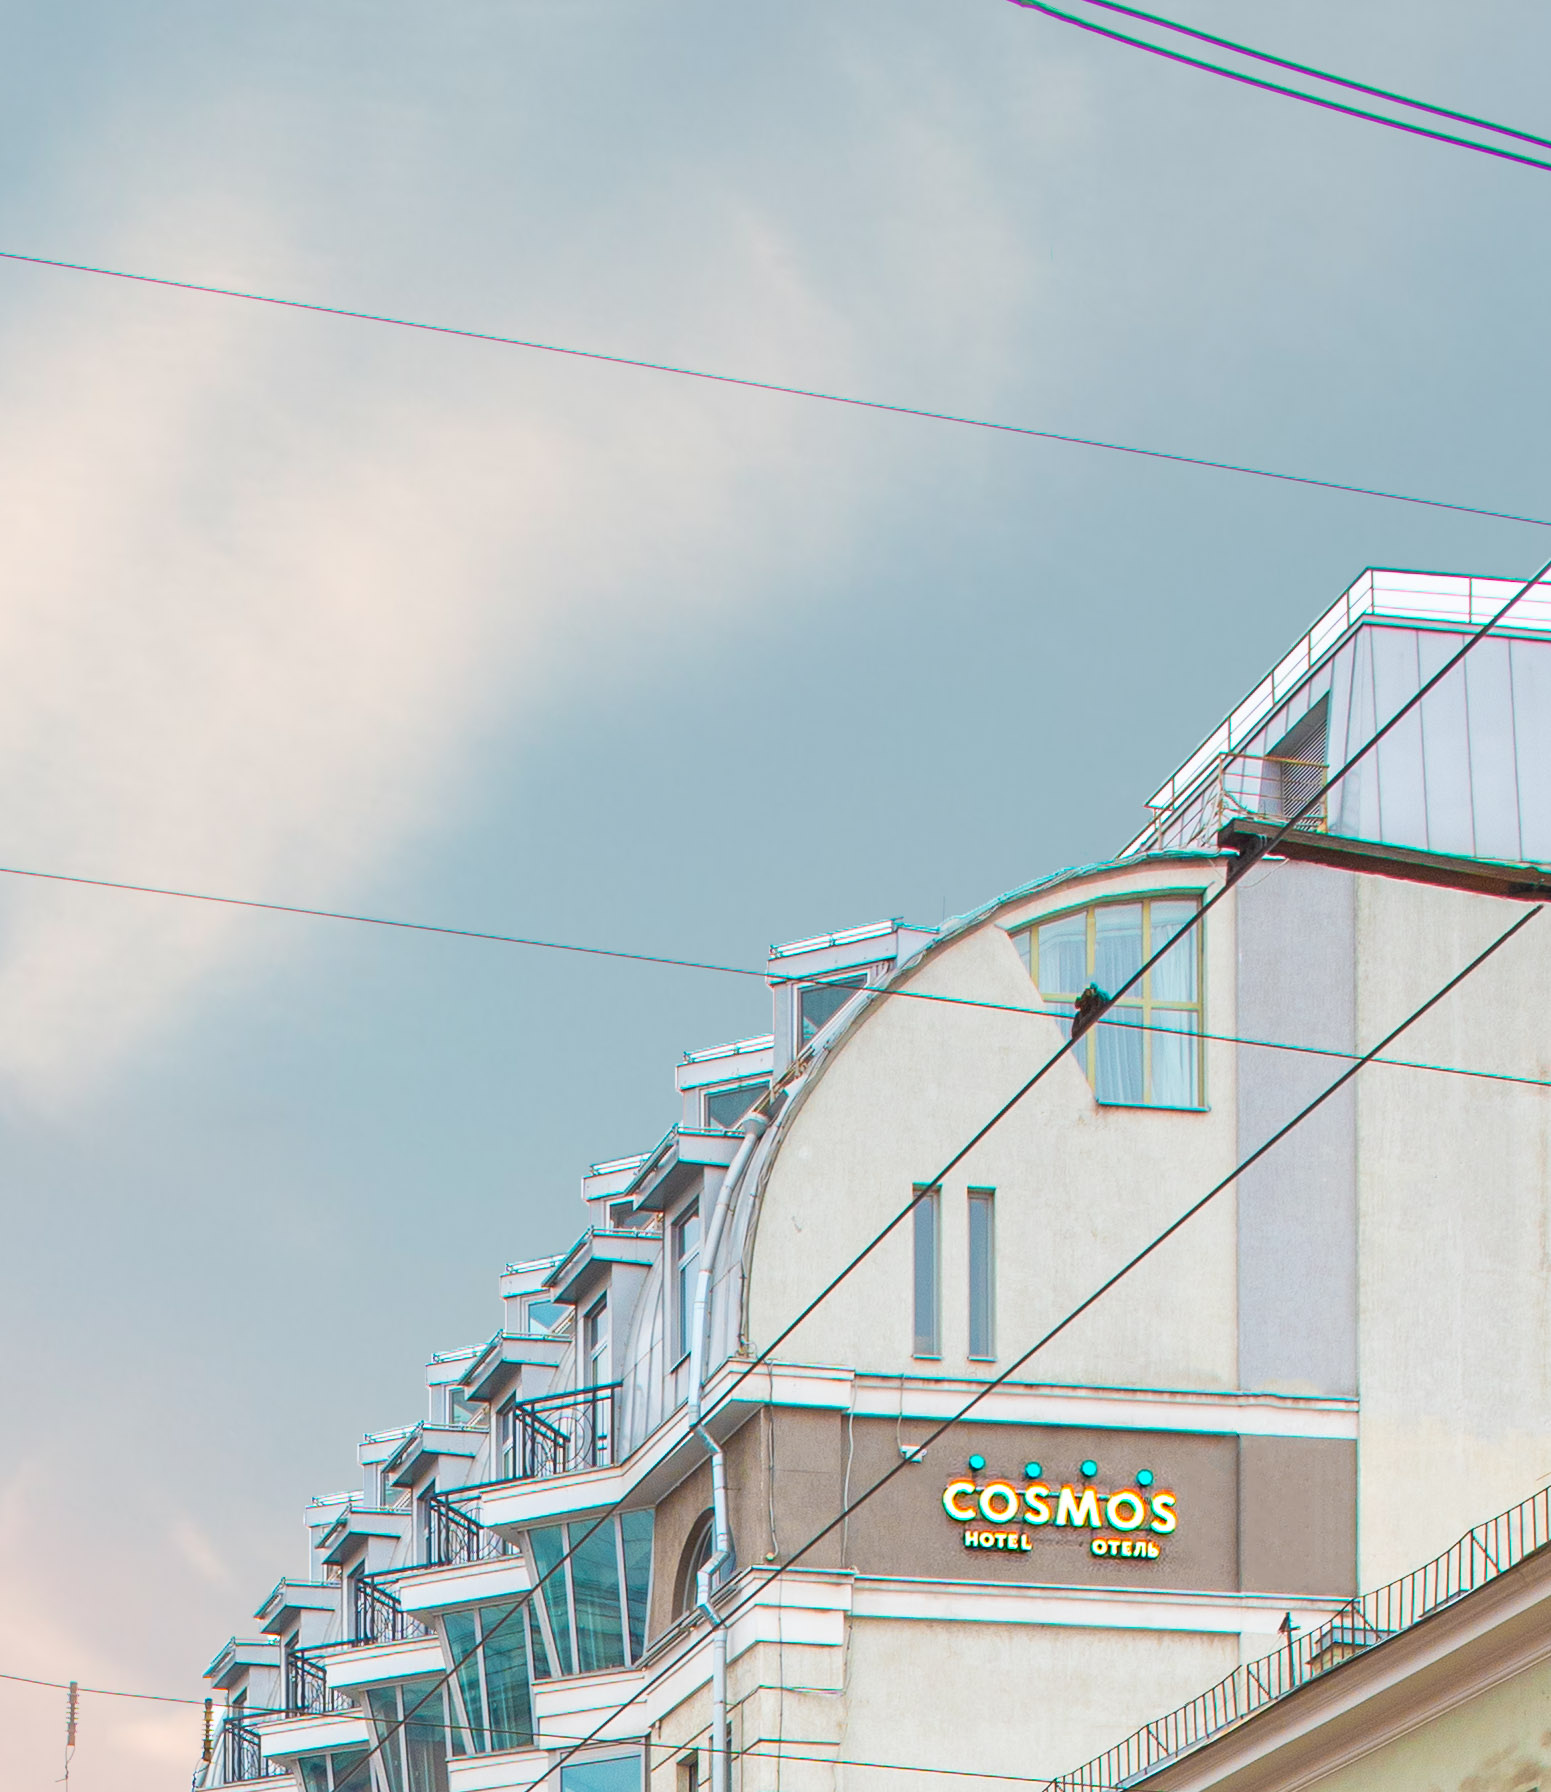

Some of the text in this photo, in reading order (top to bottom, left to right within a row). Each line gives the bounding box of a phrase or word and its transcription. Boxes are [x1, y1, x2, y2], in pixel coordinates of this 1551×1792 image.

[942, 1479, 1177, 1535] COSMOS
[964, 1530, 1033, 1551] HOTEL
[1090, 1539, 1160, 1559] ОТЕЛЬ
